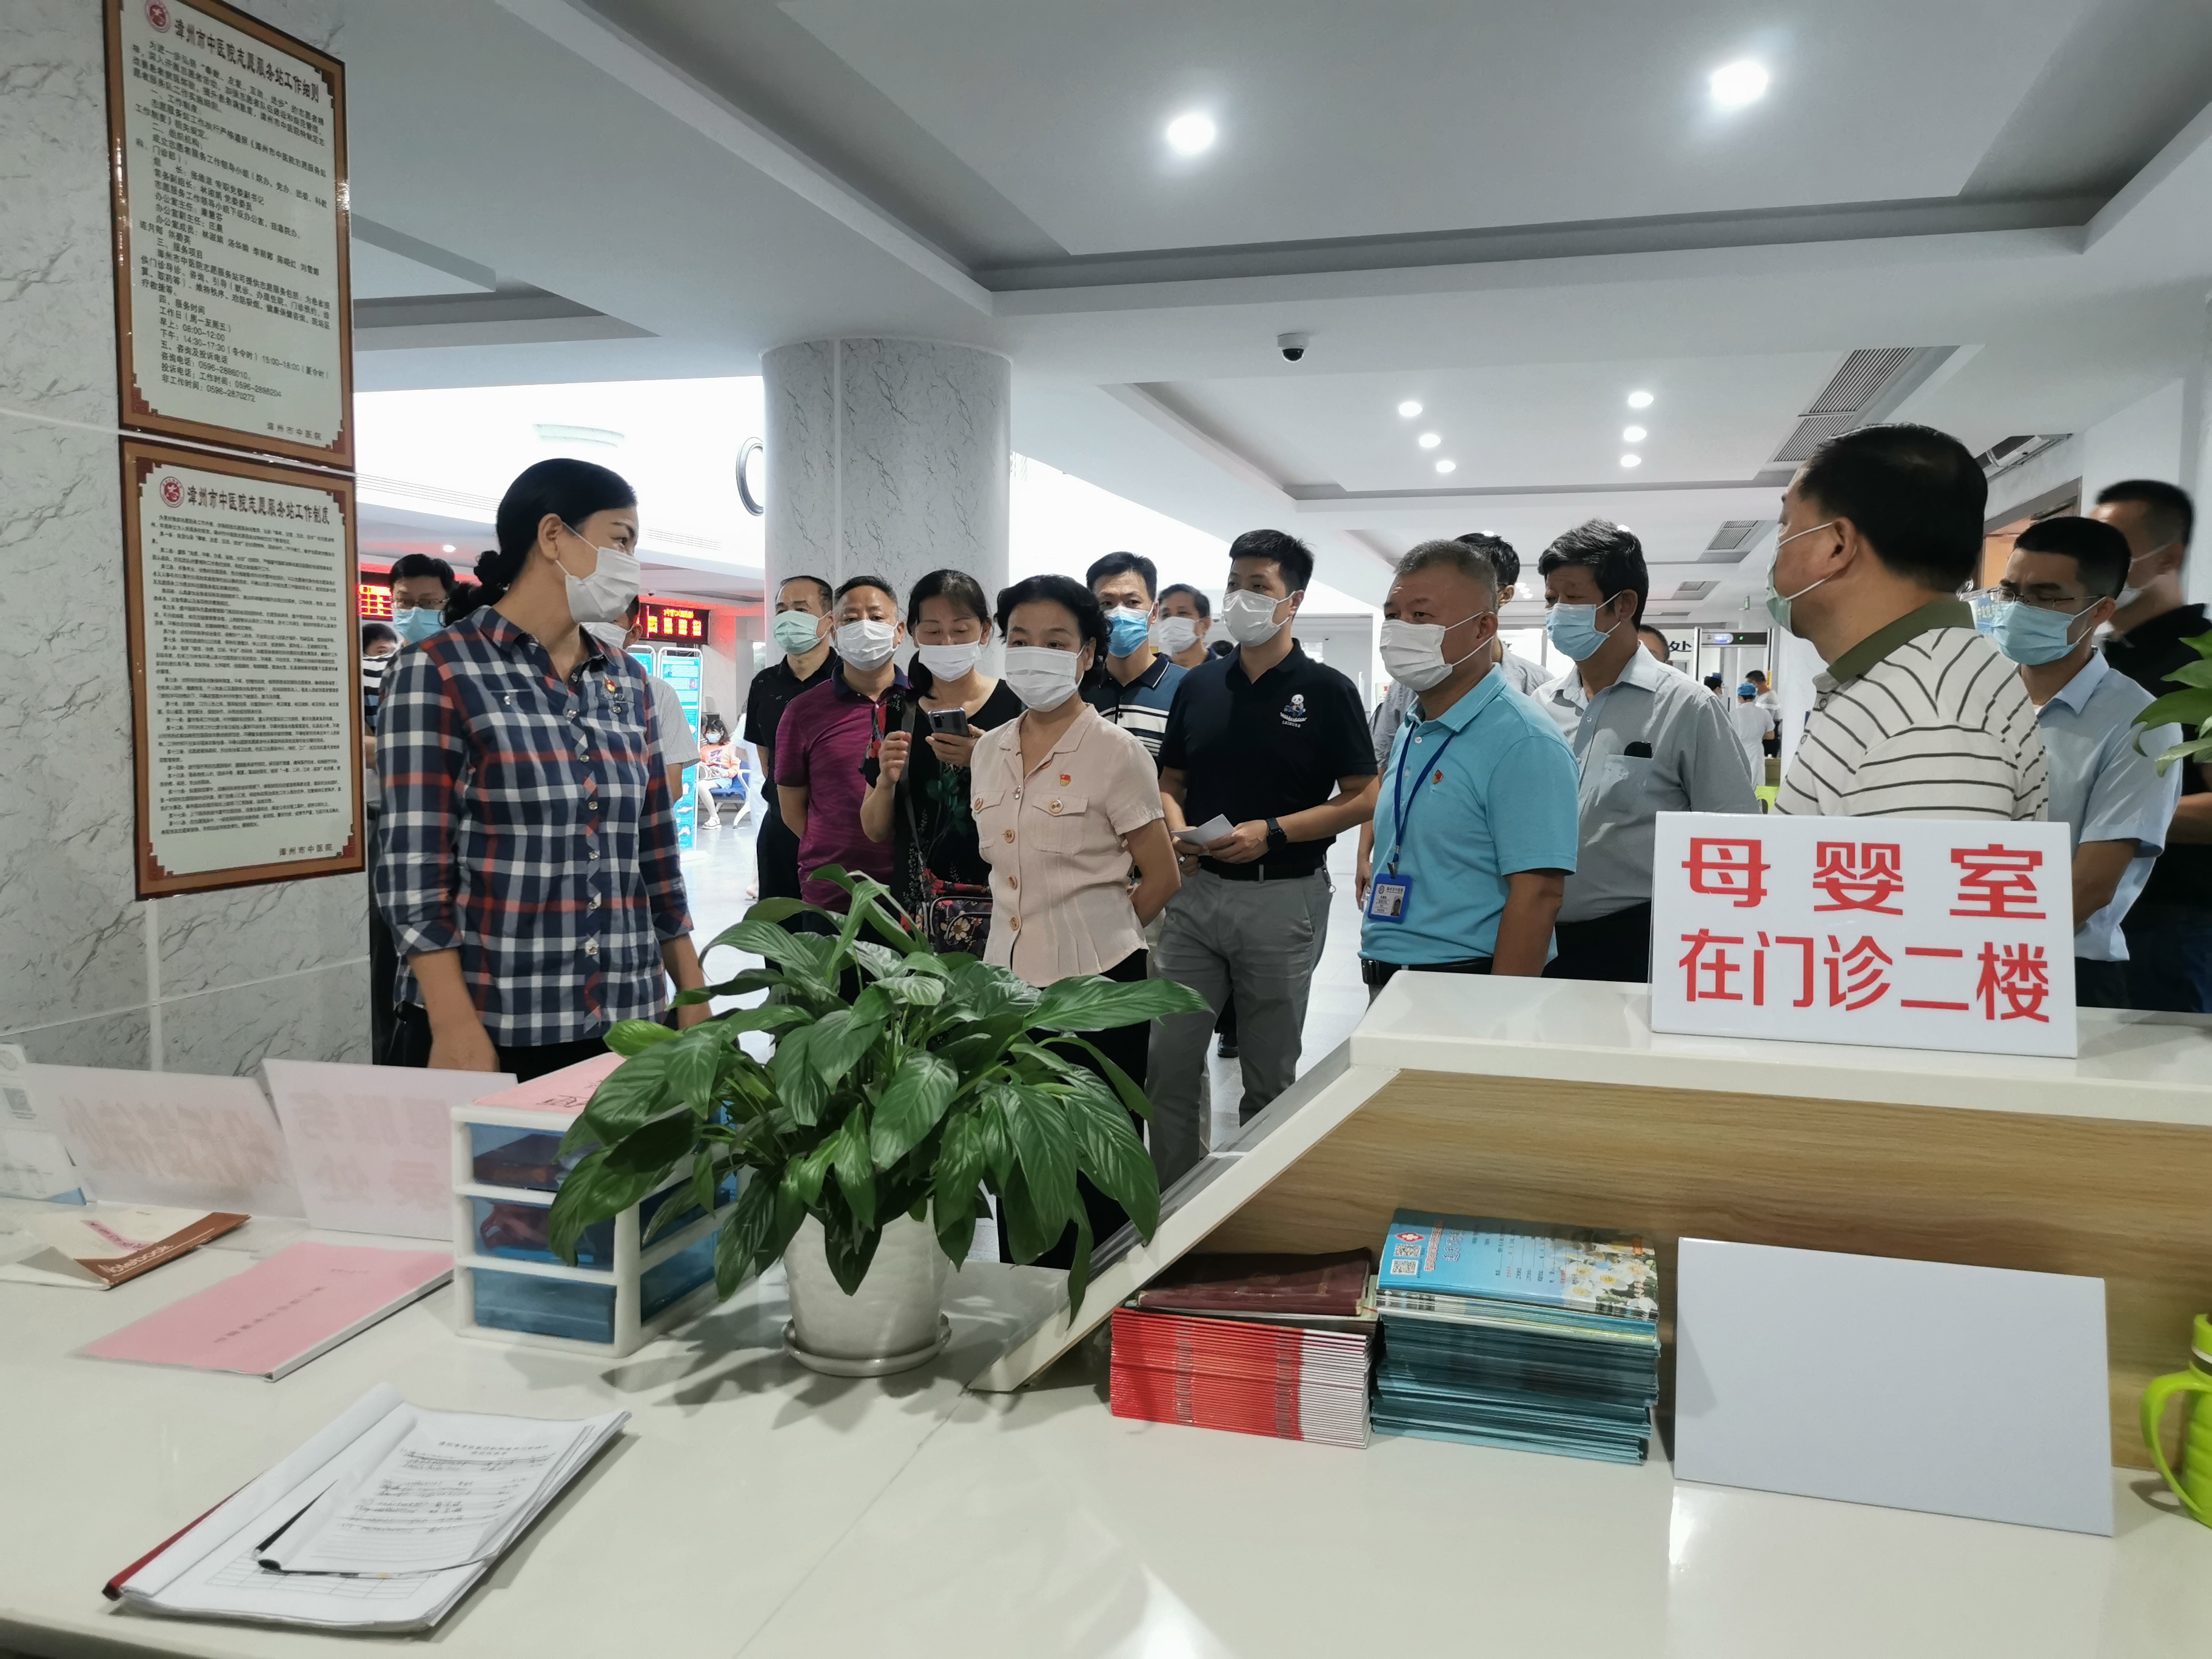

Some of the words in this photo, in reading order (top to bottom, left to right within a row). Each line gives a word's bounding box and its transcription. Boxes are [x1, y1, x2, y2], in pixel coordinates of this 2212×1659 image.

[278, 843, 333, 857] 漳州市中医院
[1681, 837, 2046, 920] 母婴室
[1678, 928, 2049, 1023] 在门诊二楼
